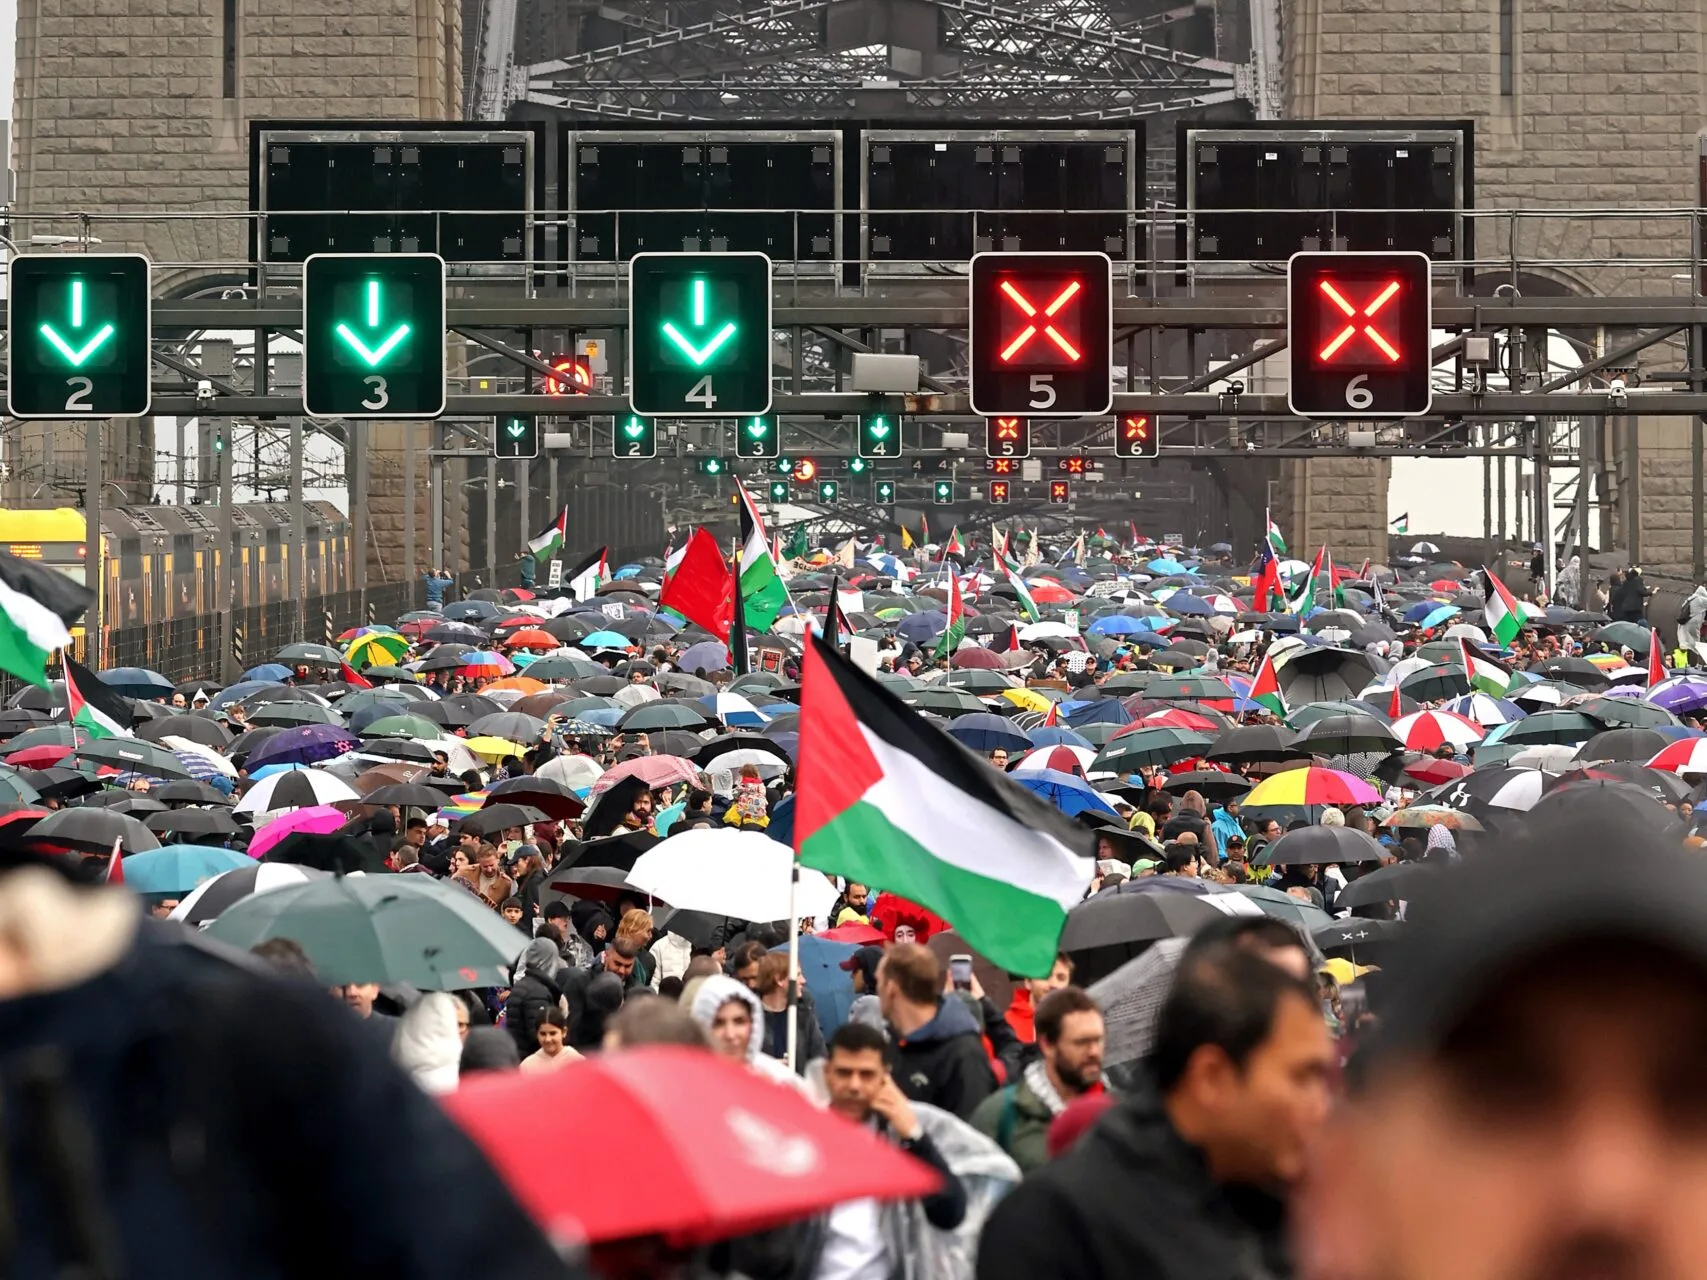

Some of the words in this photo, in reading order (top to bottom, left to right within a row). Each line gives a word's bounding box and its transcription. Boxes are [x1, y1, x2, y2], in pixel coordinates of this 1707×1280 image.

[65, 377, 93, 411] 2
[361, 376, 389, 410] 3
[684, 376, 717, 409] 4
[1028, 375, 1056, 409] 5
[1345, 375, 1373, 409] 6
[513, 442, 519, 456] 1
[629, 442, 641, 456] 2
[752, 442, 764, 456] 3
[873, 442, 886, 456] 4
[1002, 442, 1014, 456] 5
[1130, 441, 1142, 456] 6
[699, 461, 703, 471] 1
[724, 461, 728, 471] 1
[769, 461, 777, 470] 2
[795, 461, 802, 470] 2
[841, 460, 849, 469] 3
[867, 460, 875, 469] 3
[912, 460, 922, 469] 4
[938, 460, 947, 469] 4
[986, 460, 994, 469] 5
[1012, 460, 1019, 469] 5
[1059, 460, 1067, 469] 6
[1084, 460, 1092, 469] 6
